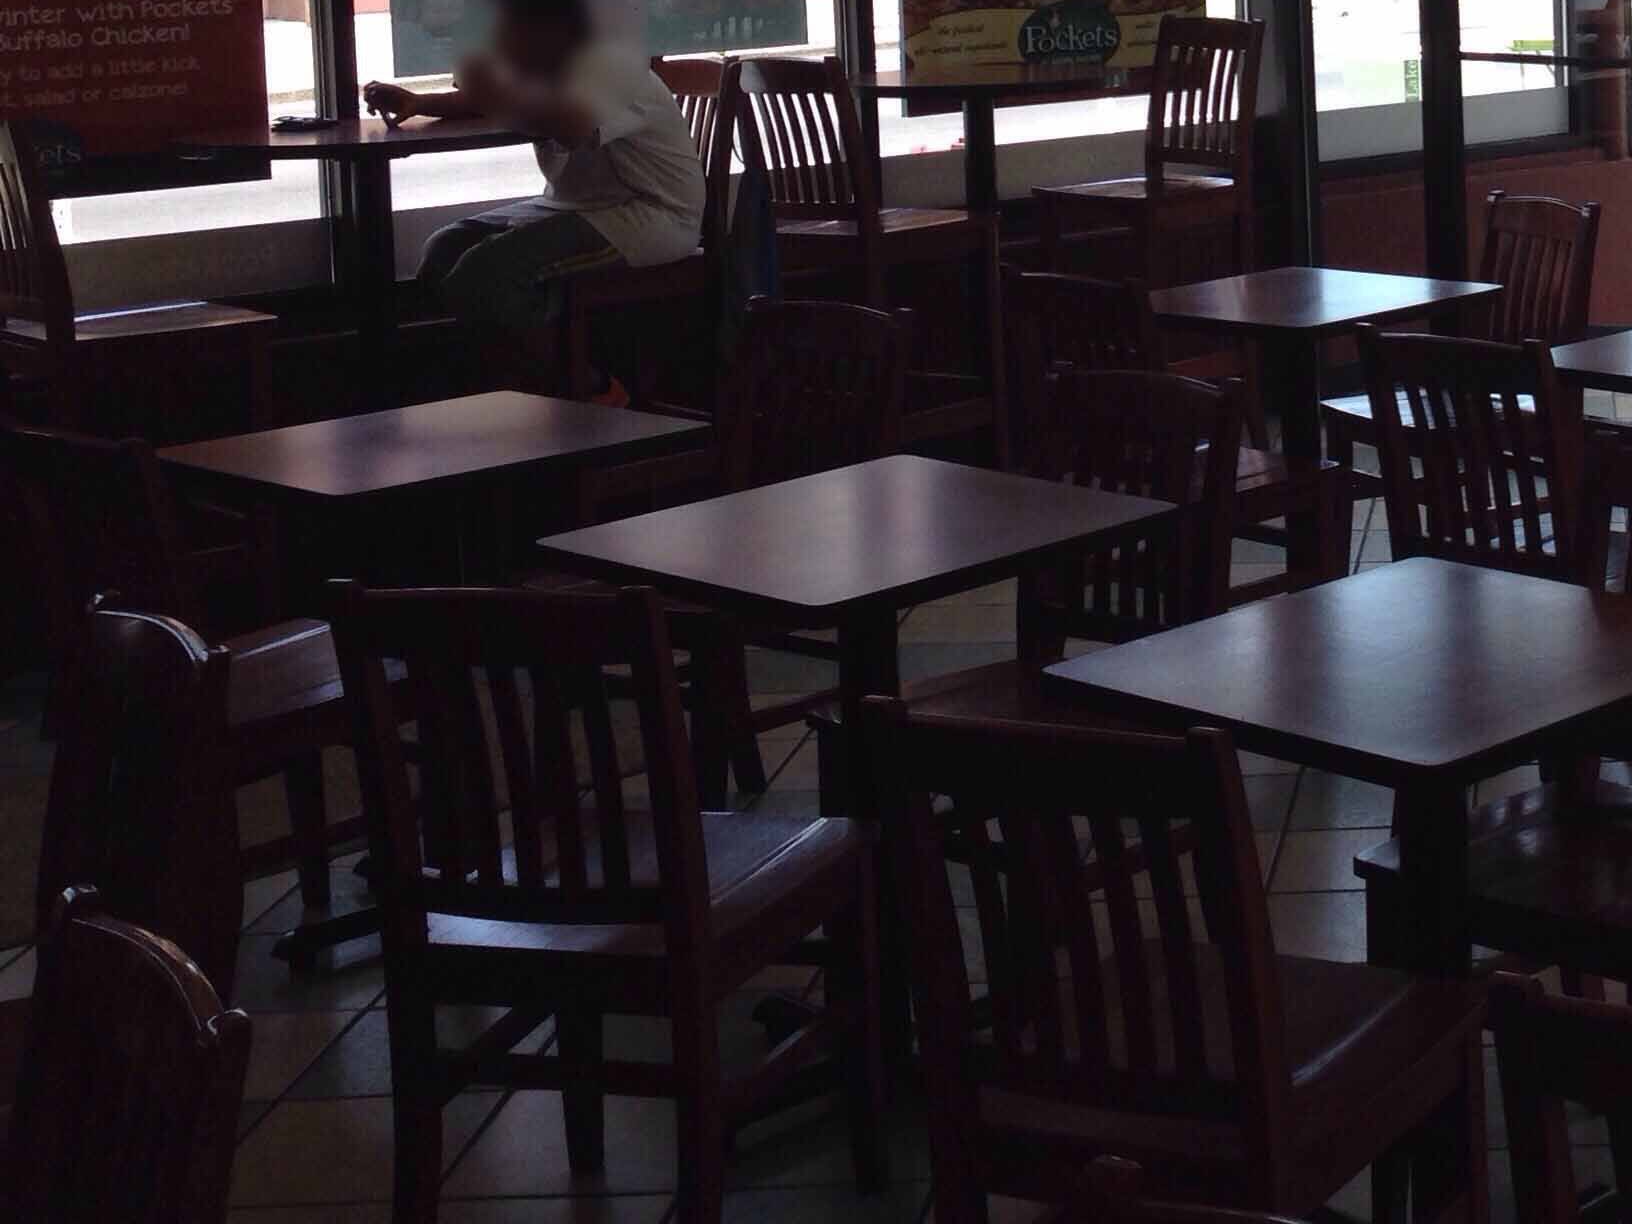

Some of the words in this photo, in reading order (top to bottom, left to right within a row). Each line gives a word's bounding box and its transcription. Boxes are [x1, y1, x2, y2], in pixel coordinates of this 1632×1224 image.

[76, 2, 134, 23] with
[91, 24, 191, 47] Chicken!
[1022, 23, 1118, 54] Pockets
